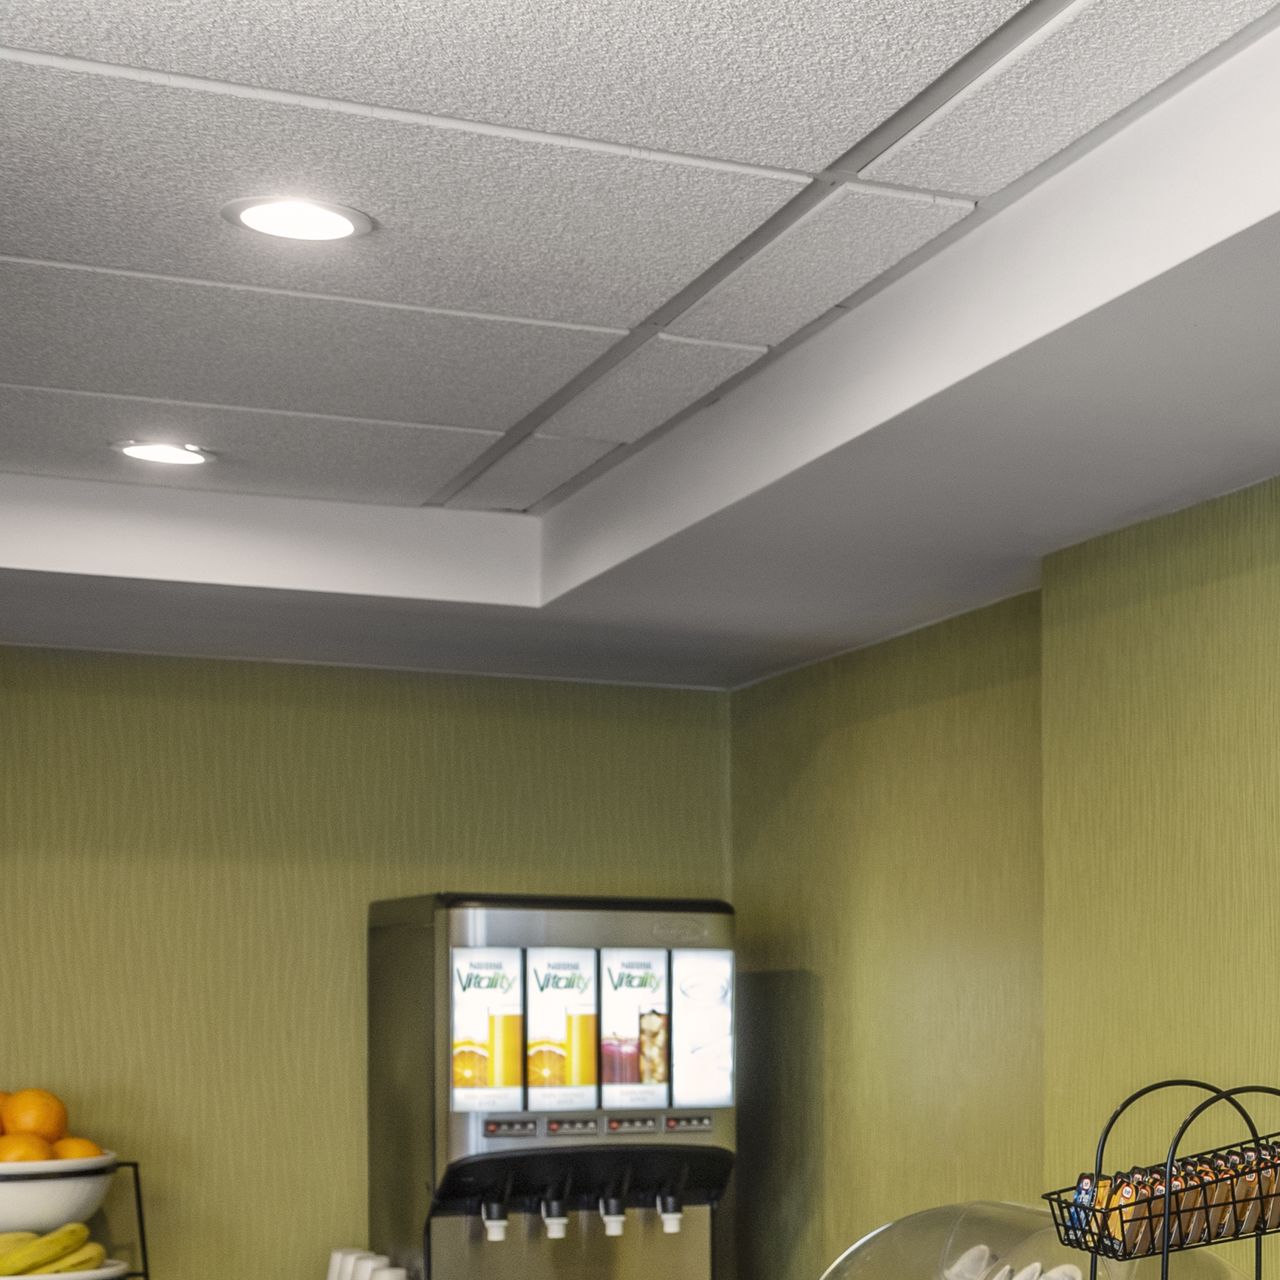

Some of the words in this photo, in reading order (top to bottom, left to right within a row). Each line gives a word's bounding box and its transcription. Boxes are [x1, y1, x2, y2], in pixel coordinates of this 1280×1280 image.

[456, 967, 516, 993] Vitality
[533, 967, 593, 993] Vitality
[607, 966, 663, 992] Vitality
